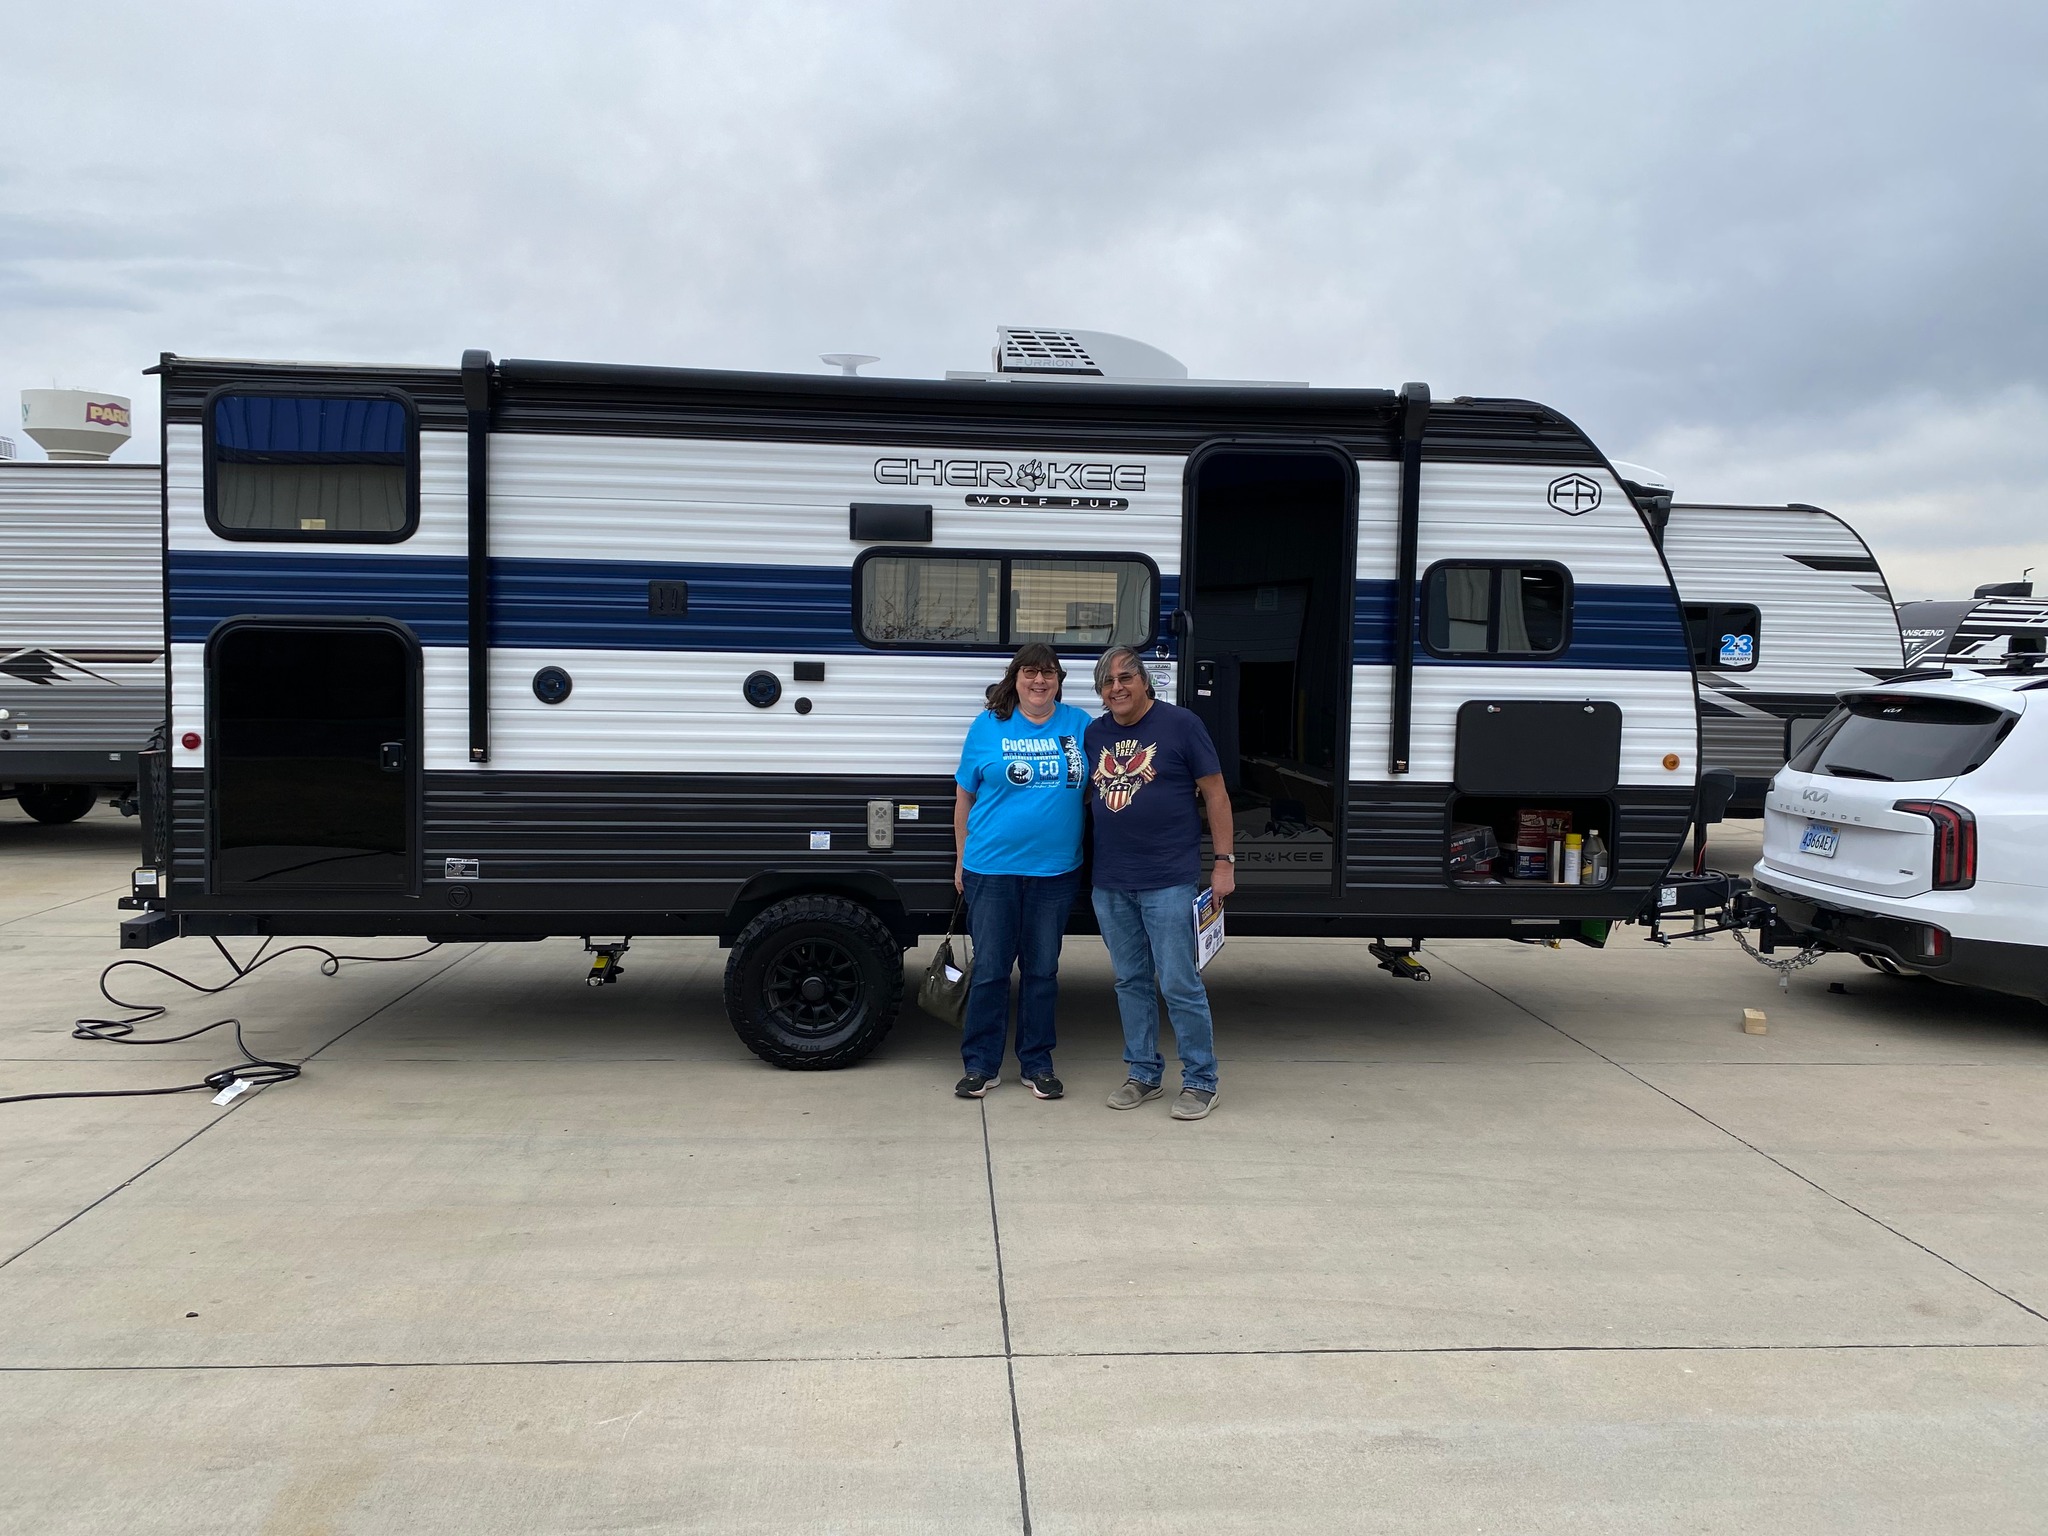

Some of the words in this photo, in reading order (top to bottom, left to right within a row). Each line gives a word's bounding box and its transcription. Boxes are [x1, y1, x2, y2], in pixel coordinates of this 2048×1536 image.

[1015, 358, 1075, 367] FURRION
[90, 406, 129, 423] PARK
[873, 457, 1147, 492] CHEROKEE
[976, 495, 1048, 507] WOLF
[1070, 498, 1119, 509] PUP
[1901, 629, 1945, 637] ANSCEND
[1002, 738, 1058, 752] CUCHARA
[1115, 740, 1138, 751] BORN
[1115, 749, 1135, 757] FREE
[1039, 761, 1059, 776] CO
[1780, 803, 1861, 821] TELLURIDE
[1802, 832, 1836, 852] 4366AEX
[1200, 851, 1325, 863] CEROKEE
